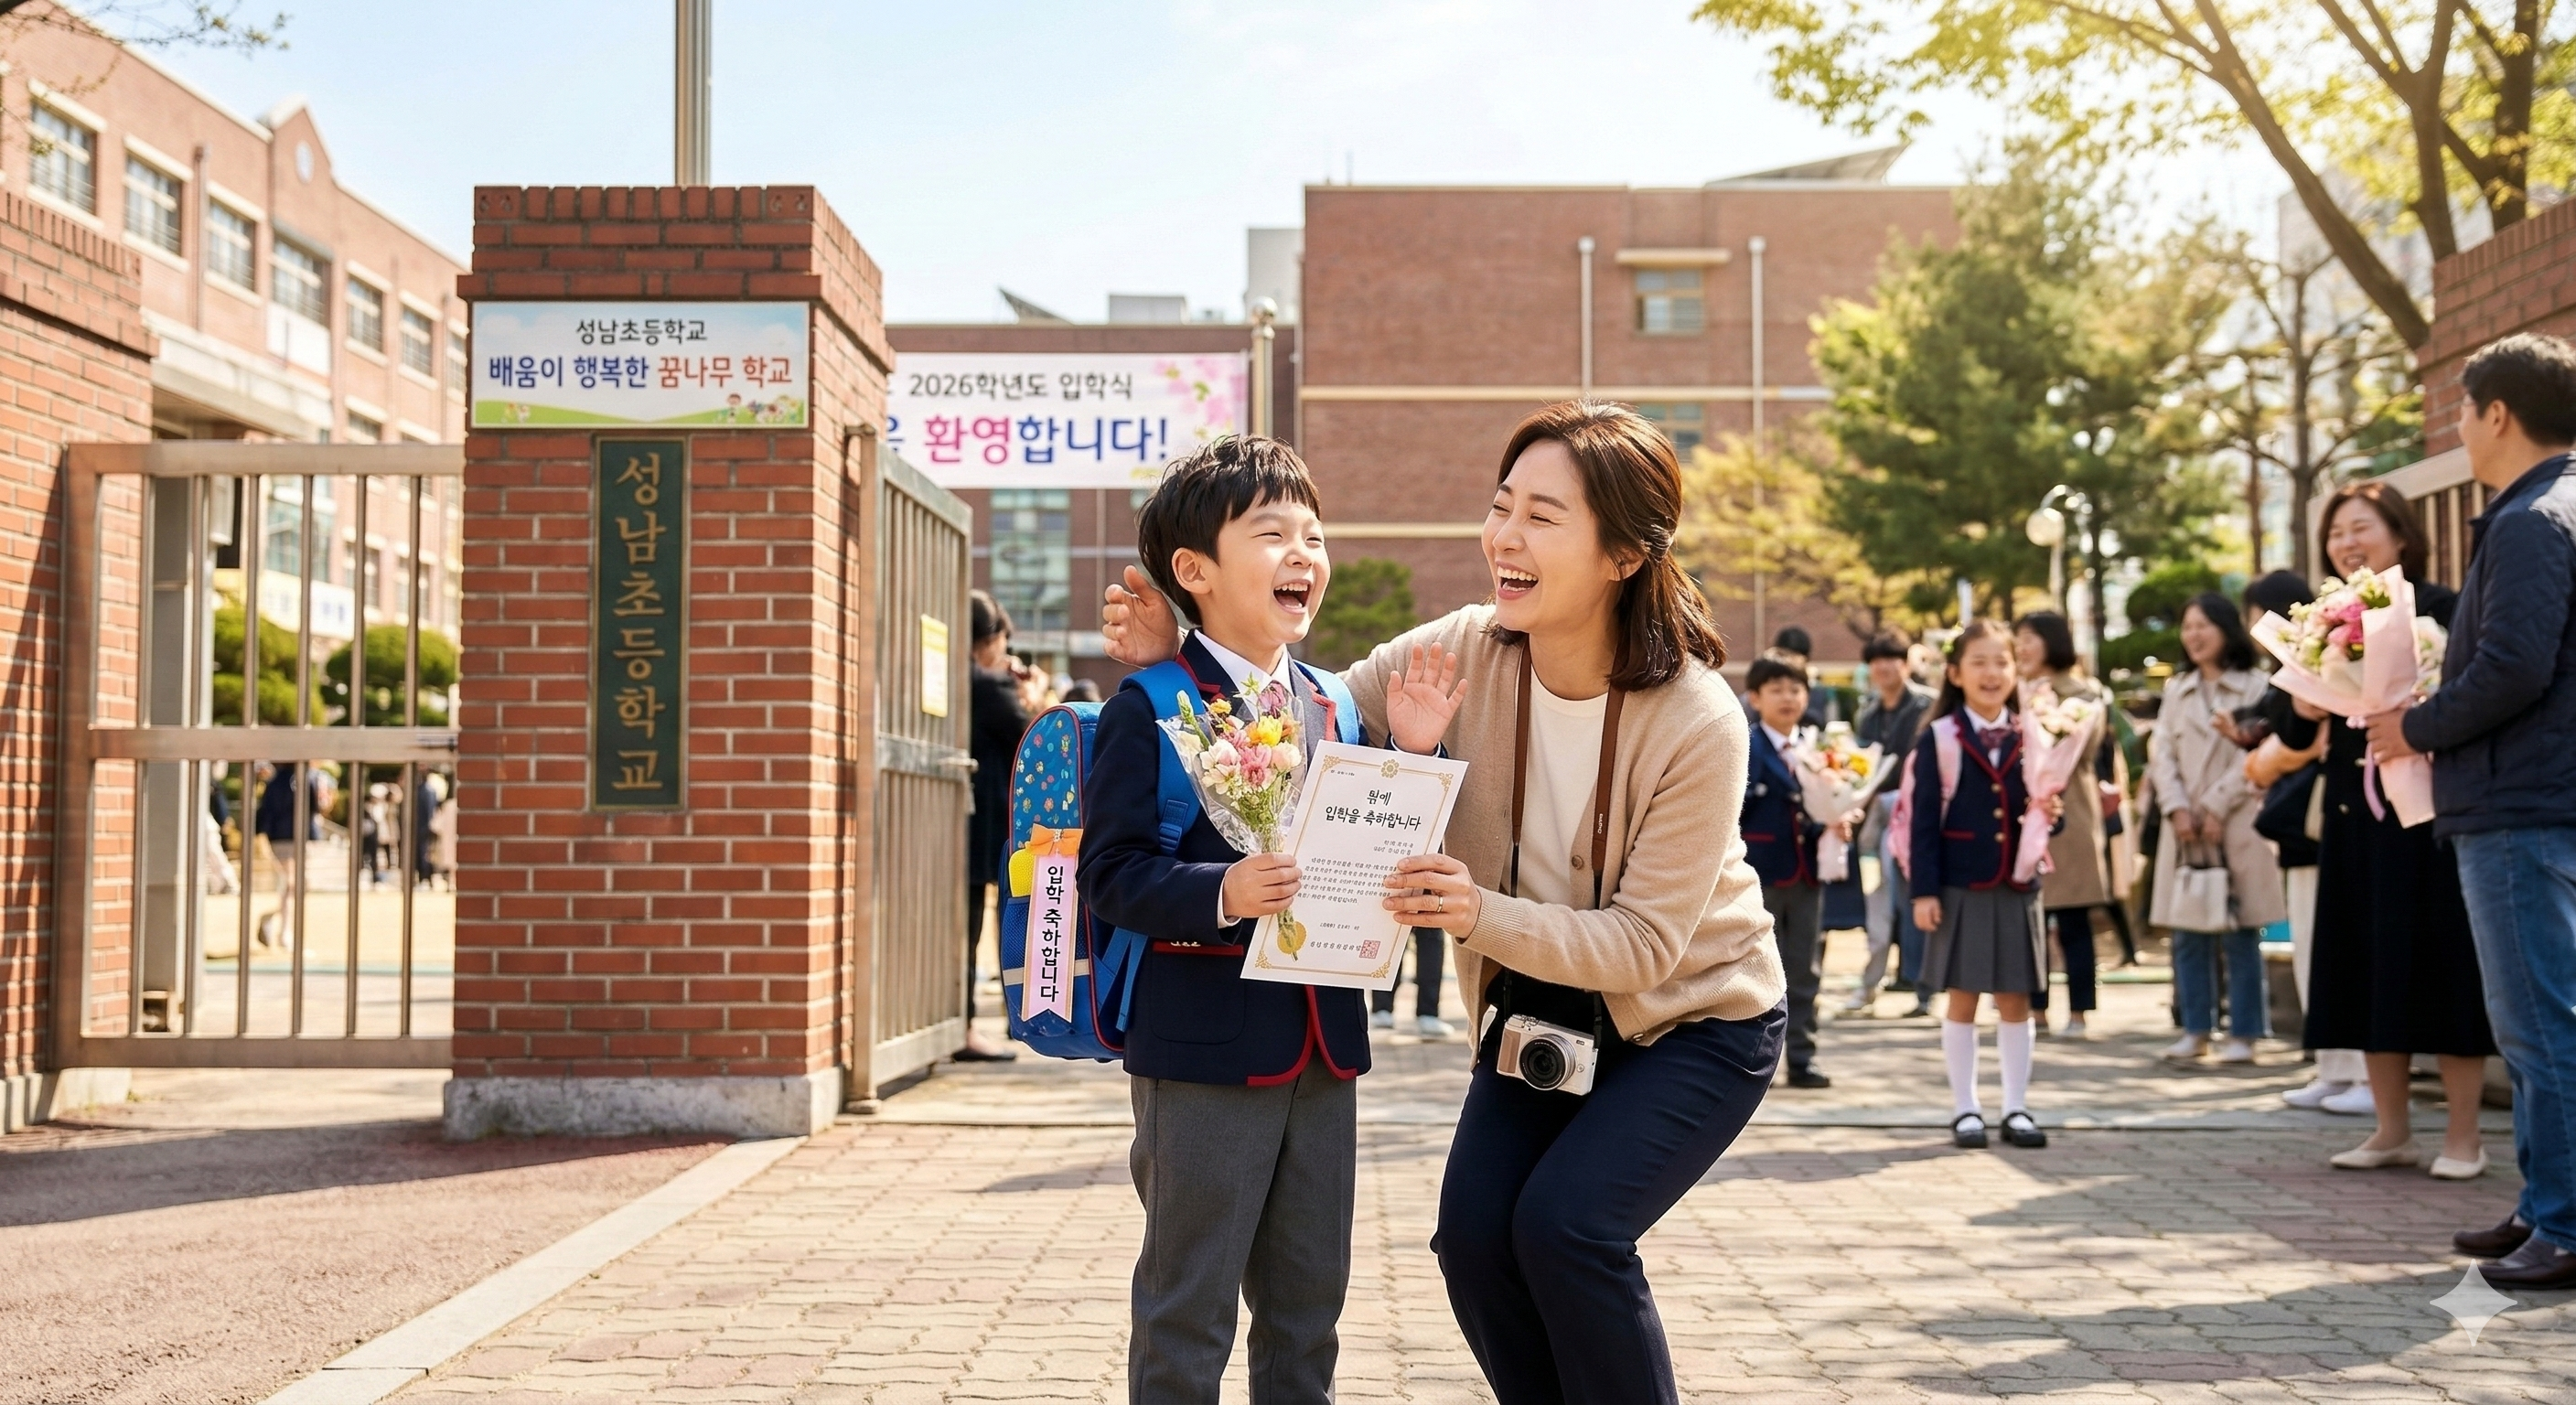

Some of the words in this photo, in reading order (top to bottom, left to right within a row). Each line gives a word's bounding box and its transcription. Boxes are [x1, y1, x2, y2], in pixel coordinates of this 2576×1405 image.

[575, 318, 707, 346] 성남초등학교
[488, 355, 564, 389] 배움이
[574, 355, 650, 389] 행복한
[657, 356, 734, 388] 꿈나무
[742, 355, 793, 389] 학교
[910, 372, 1049, 401] 2026학년도
[1058, 372, 1133, 401] 입학식
[924, 414, 1168, 465] 환영합니다!
[612, 453, 667, 791] 성남초등학교
[1363, 810, 1422, 831] 축하합니다
[1046, 865, 1064, 905] 입학
[1040, 908, 1062, 1003] 축하합니다
